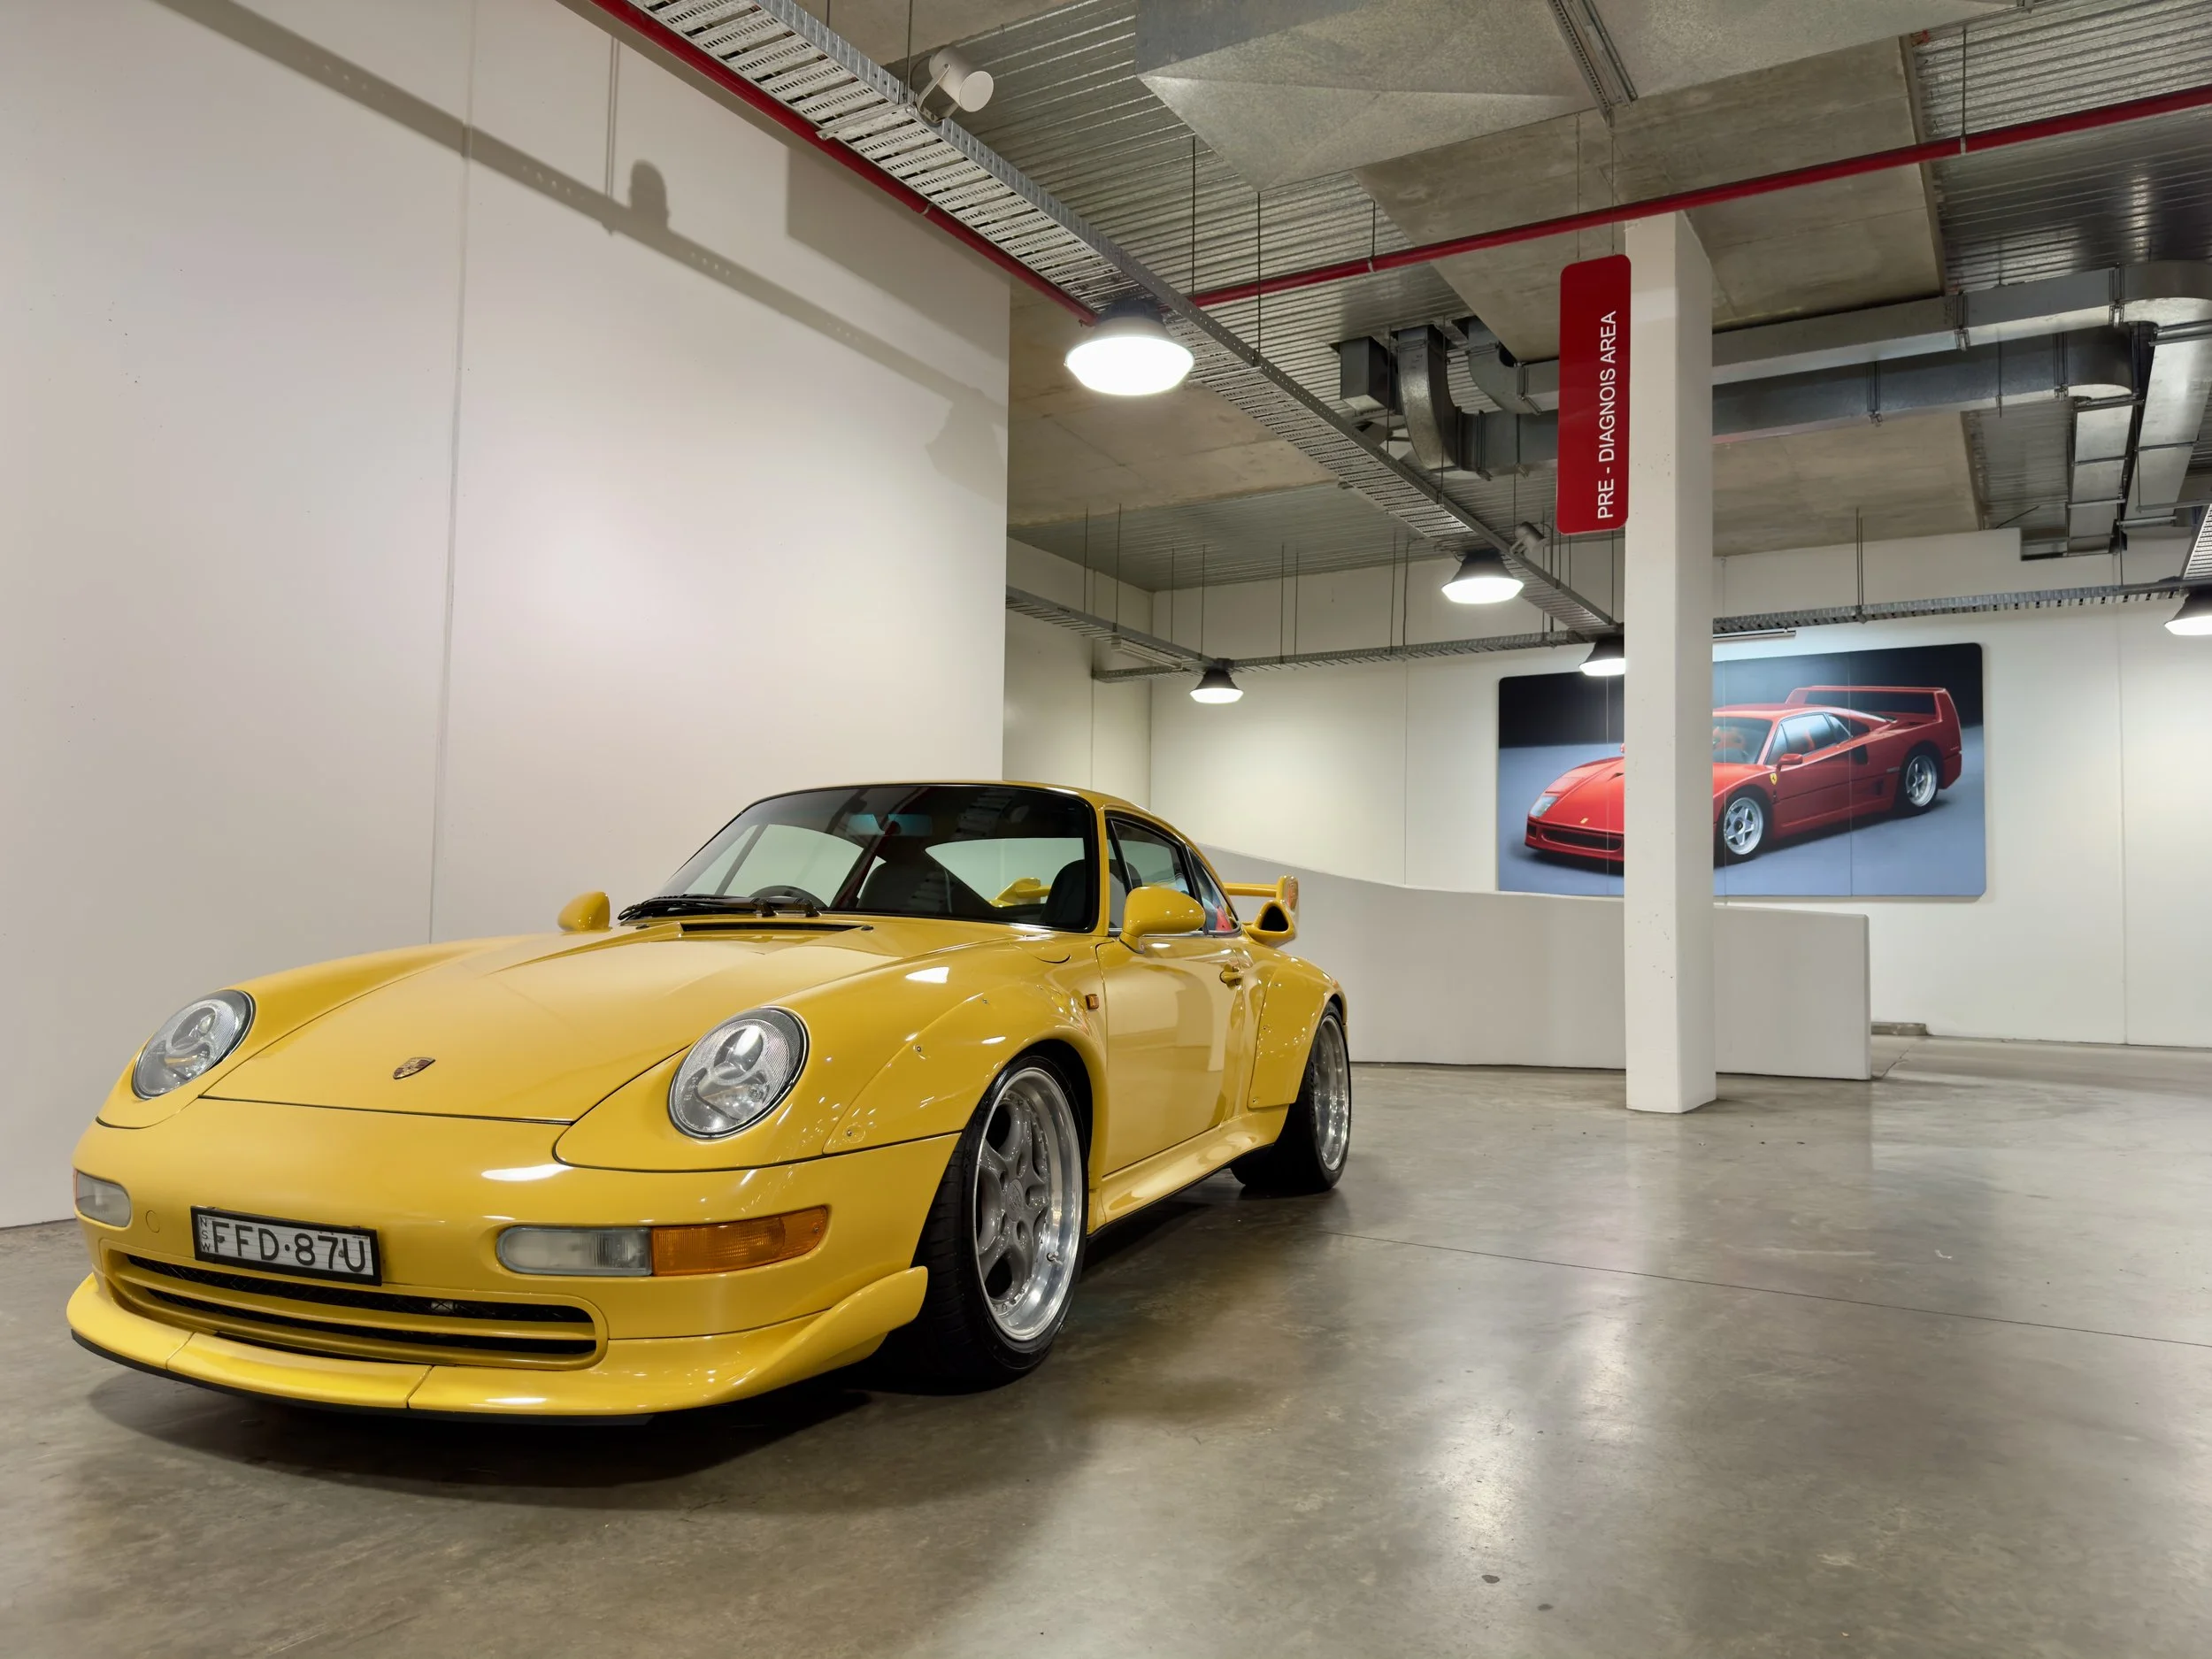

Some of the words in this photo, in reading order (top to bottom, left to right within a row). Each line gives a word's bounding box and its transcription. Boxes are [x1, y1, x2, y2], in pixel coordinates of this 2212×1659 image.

[1600, 310, 1617, 364] AREA
[1598, 368, 1617, 463] DIAGNOIS
[1597, 479, 1615, 519] PRE
[199, 1216, 211, 1253] NSW
